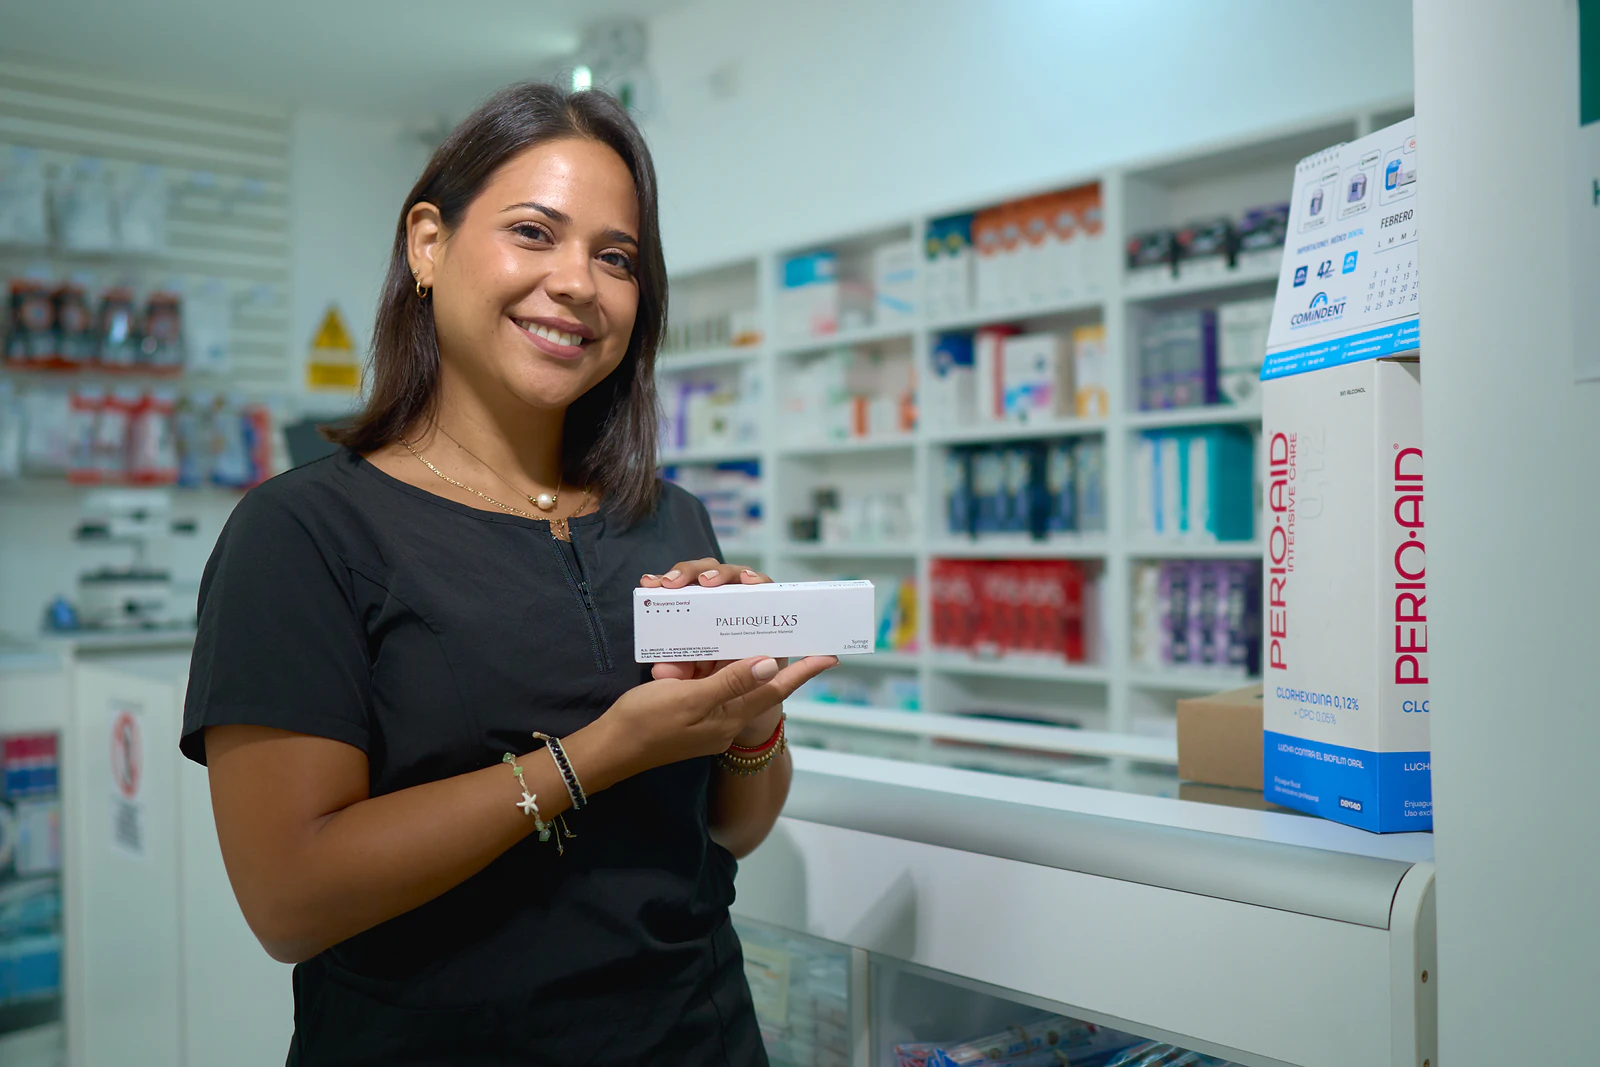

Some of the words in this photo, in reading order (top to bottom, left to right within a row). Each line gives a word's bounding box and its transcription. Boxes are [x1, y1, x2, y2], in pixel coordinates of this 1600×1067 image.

[1380, 209, 1414, 228] FEBRERO
[1317, 260, 1332, 278] 42
[1404, 272, 1410, 280] 13
[1390, 287, 1396, 295] 19
[1401, 284, 1408, 293] 20
[1412, 281, 1419, 289] 21
[1375, 302, 1382, 310] 25
[1387, 299, 1394, 307] 26
[1398, 296, 1405, 304] 27
[1410, 292, 1417, 301] 28
[1289, 432, 1298, 480] CARE
[1288, 486, 1296, 572] INTENSIVE
[716, 616, 770, 627] PALFIQUE
[772, 615, 798, 627] LX5
[1276, 686, 1332, 707] CLORHEXIDINA
[1334, 696, 1360, 711] 0,12%
[1300, 708, 1314, 720] CPC
[1316, 712, 1336, 724] 0,05%
[1278, 744, 1294, 753] LUCHA
[1295, 746, 1316, 759] CONTRA
[1316, 752, 1322, 761] EL
[1324, 754, 1346, 765] BIOFILM
[1348, 758, 1364, 769] ORAL
